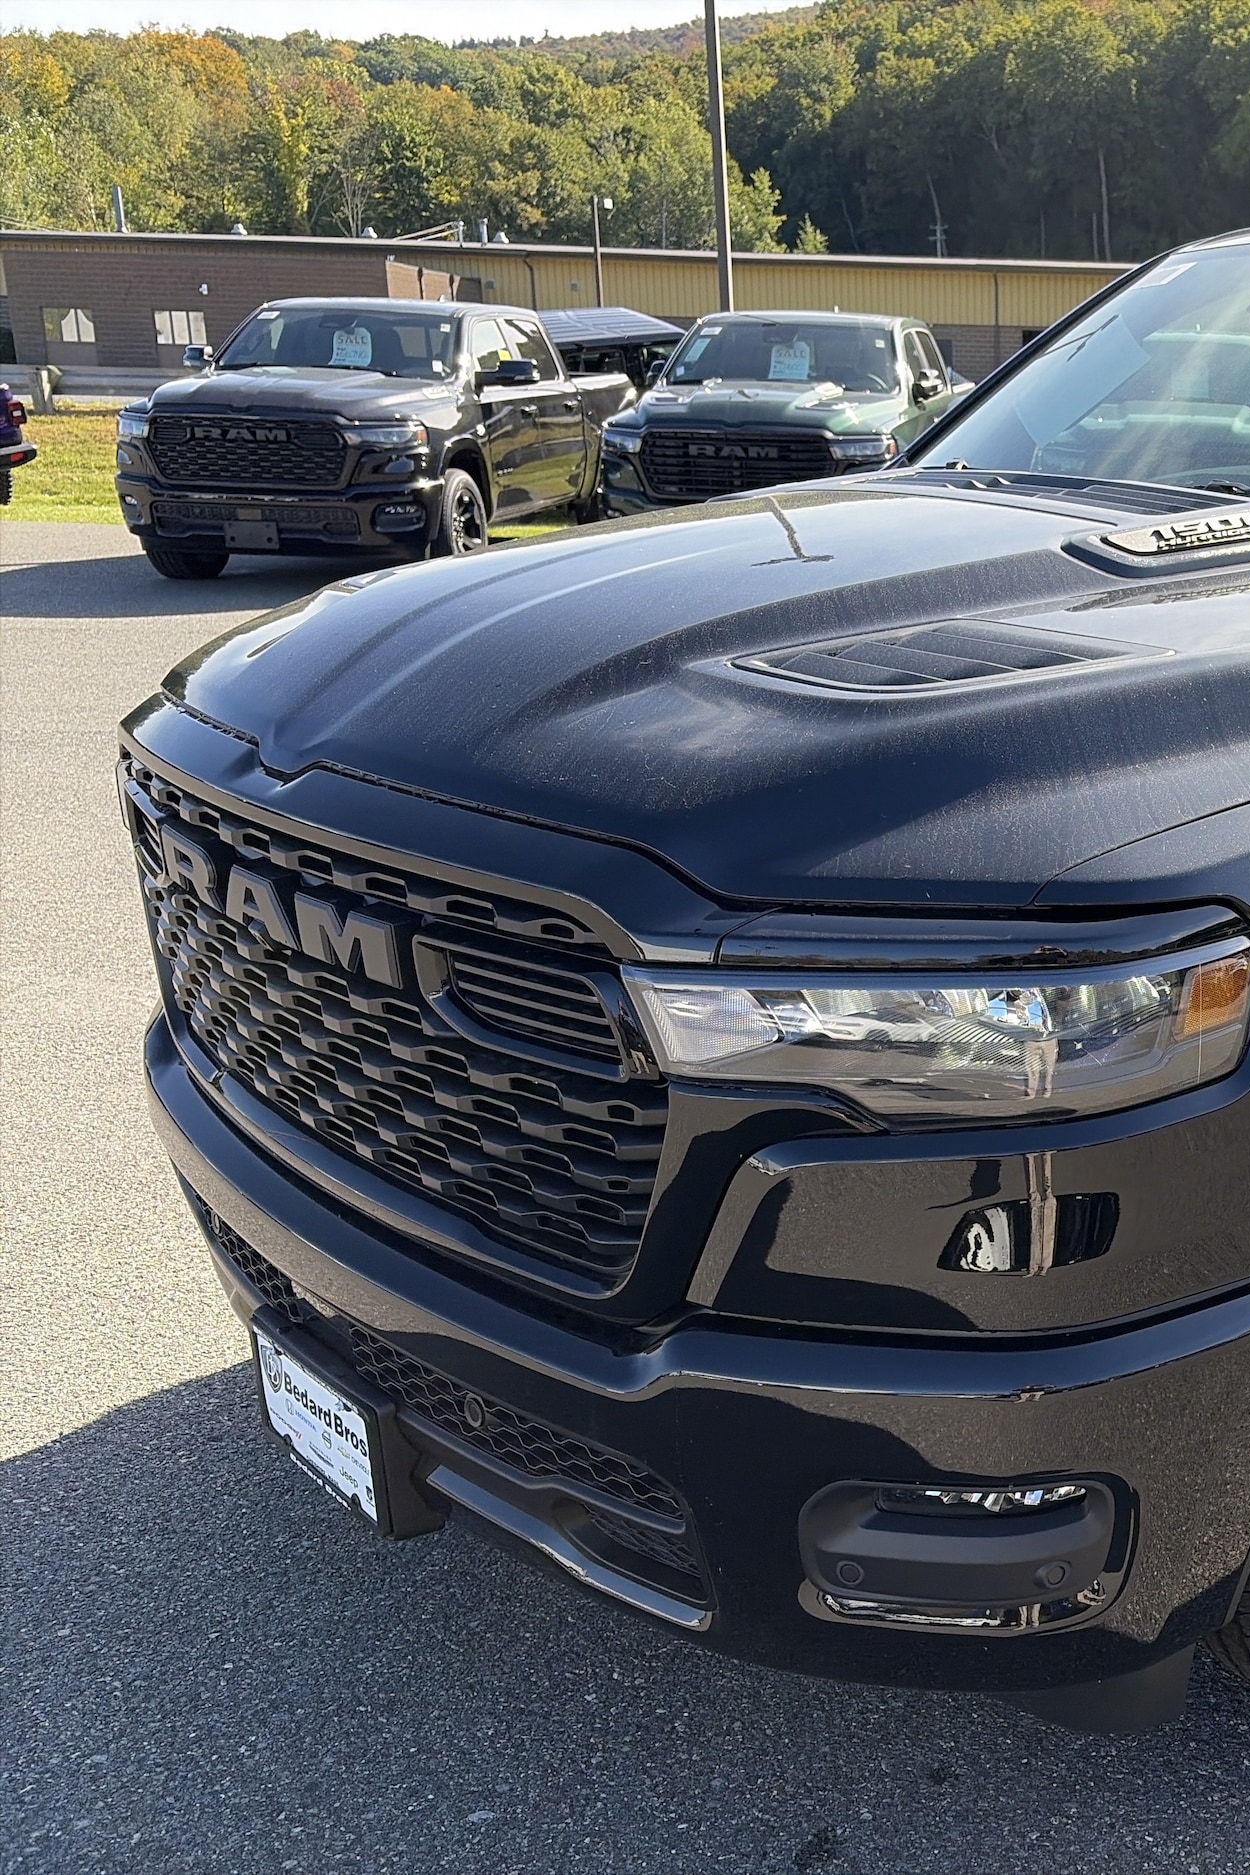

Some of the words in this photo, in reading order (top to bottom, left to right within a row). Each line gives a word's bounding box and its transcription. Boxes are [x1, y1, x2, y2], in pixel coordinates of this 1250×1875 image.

[337, 335, 368, 345] SALE
[193, 426, 288, 442] RAM
[688, 444, 778, 459] RAM
[161, 823, 403, 990] RAM
[284, 1371, 333, 1430] Bedard
[333, 1413, 369, 1458] Bros
[290, 1452, 323, 1487] Bedard
[339, 1466, 359, 1489] Jeep
